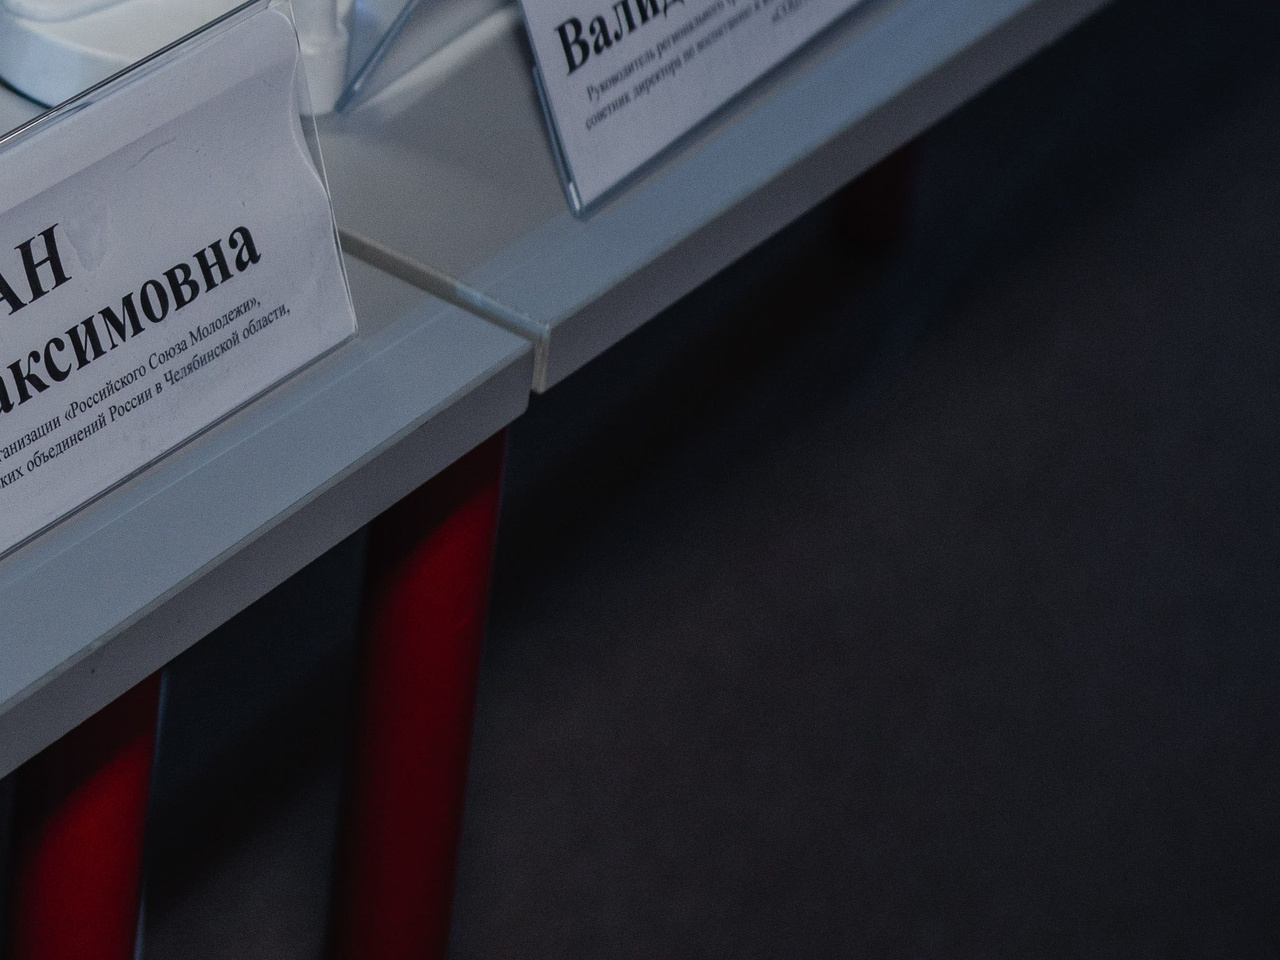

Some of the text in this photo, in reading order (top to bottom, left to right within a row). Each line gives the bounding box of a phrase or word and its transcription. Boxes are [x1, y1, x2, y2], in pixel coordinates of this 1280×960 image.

[147, 339, 189, 371] Союза
[26, 412, 108, 473] объединений
[107, 387, 153, 423] России
[154, 381, 164, 395] в
[163, 331, 241, 386] Челябинской
